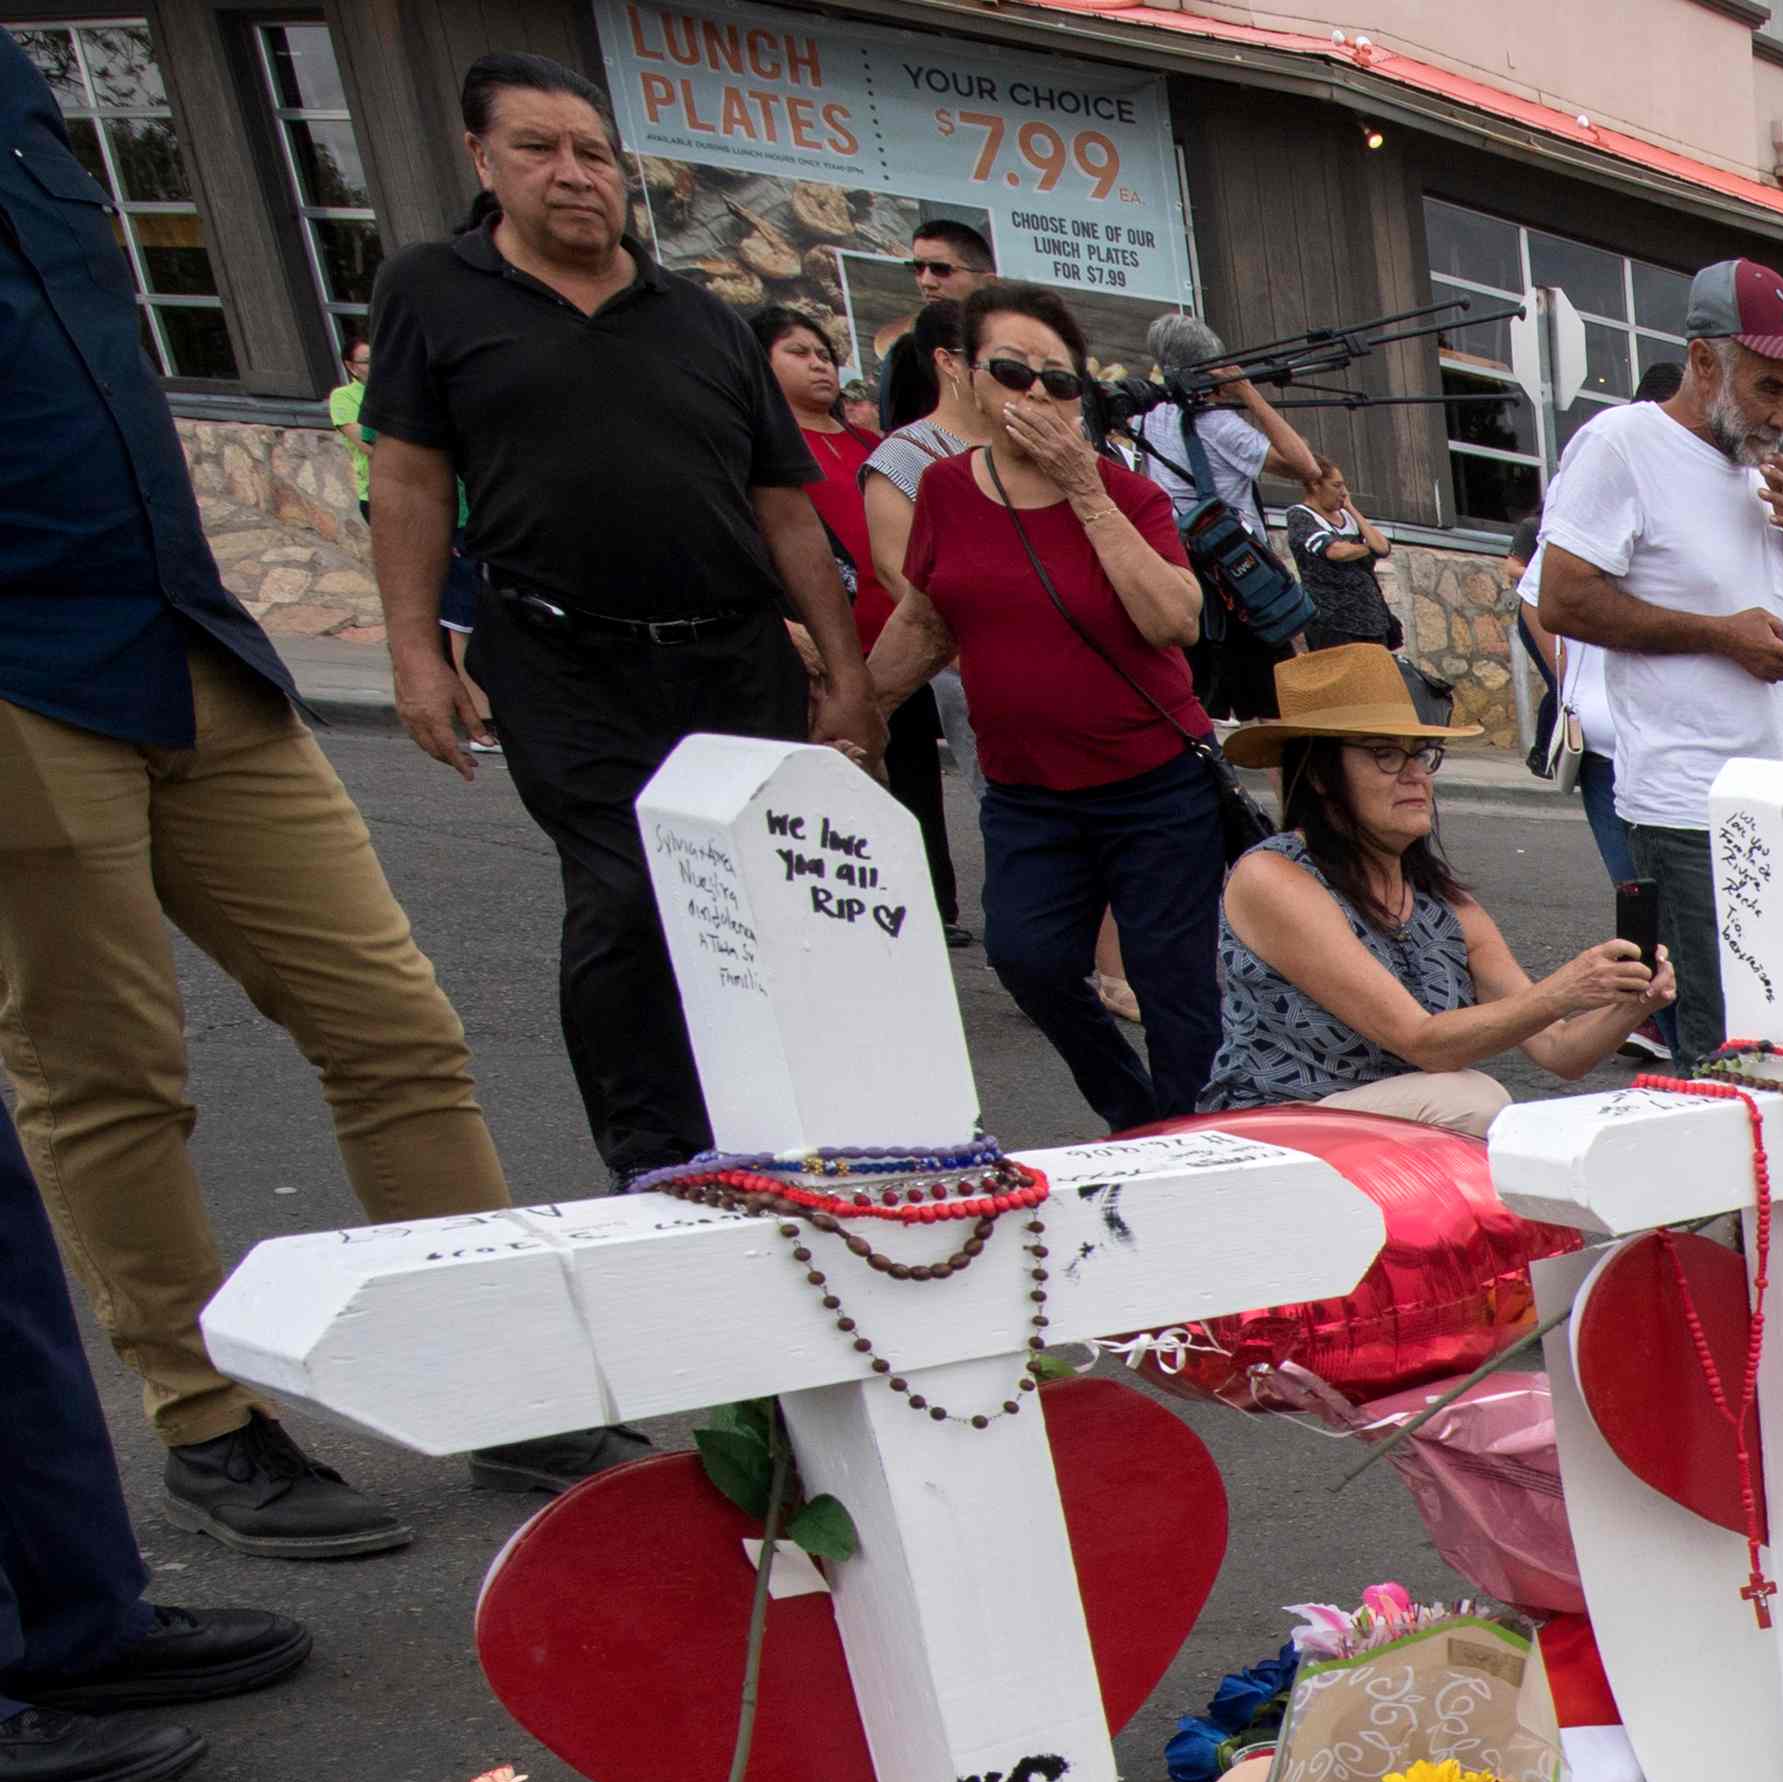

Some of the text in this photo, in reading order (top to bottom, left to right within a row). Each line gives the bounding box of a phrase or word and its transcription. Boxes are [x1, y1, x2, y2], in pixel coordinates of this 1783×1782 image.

[626, 2, 822, 88] LUNCH
[639, 71, 860, 157] PLATES
[903, 61, 1136, 125] YOUR CHOICE
[935, 107, 1121, 202] $7.99
[1010, 211, 1156, 249] CHOOSE ONE OF OUR
[1034, 236, 1140, 268] LUNCH PLATES
[1053, 260, 1127, 288] FOR $7.99
[811, 886, 866, 922] RIP
